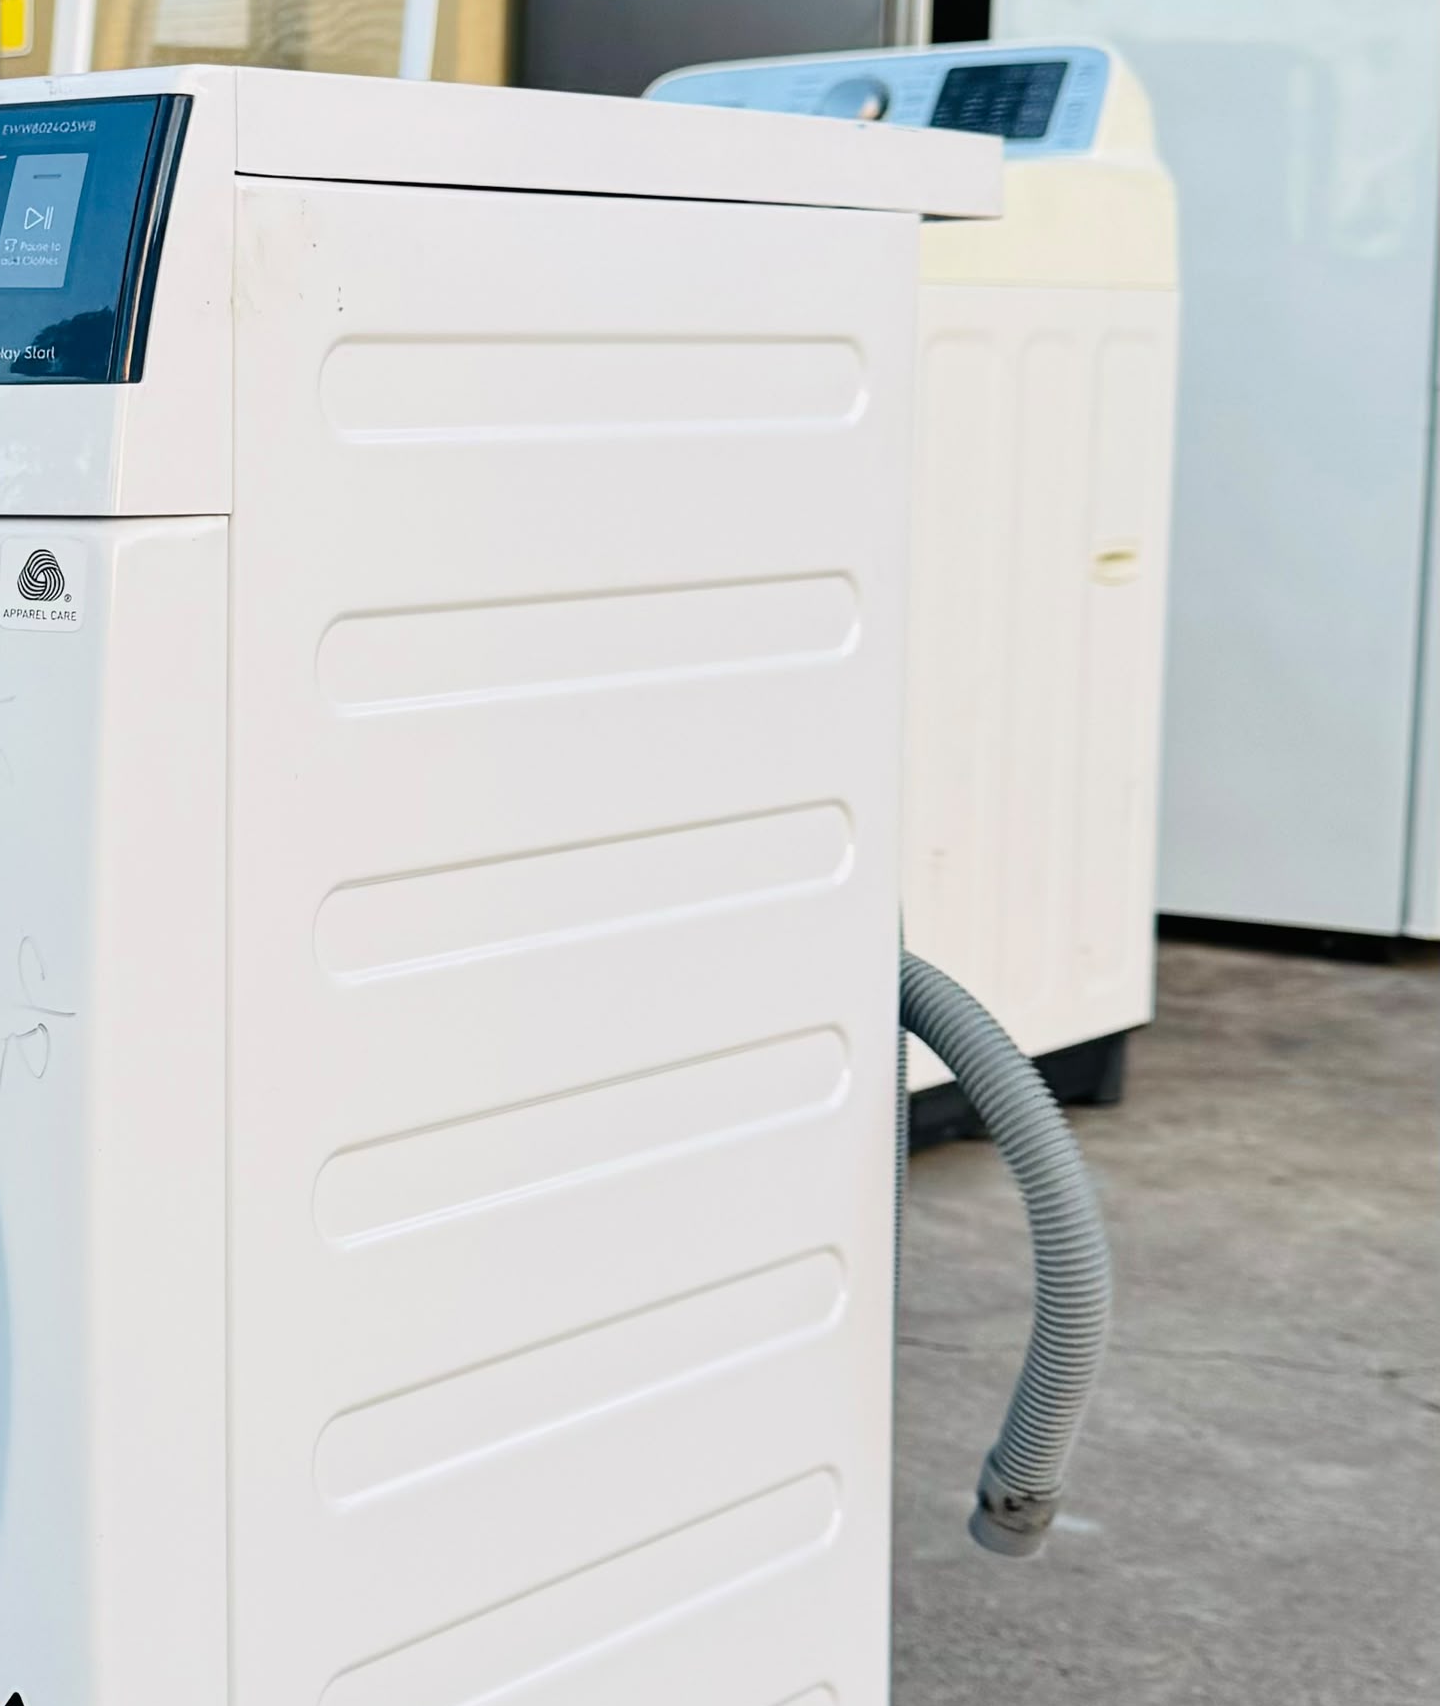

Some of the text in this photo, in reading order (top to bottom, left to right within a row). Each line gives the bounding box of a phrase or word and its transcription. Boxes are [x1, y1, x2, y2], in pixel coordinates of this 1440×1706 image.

[22, 254, 59, 267] Clothes
[24, 345, 56, 361] Start
[2, 608, 78, 622] APPAREL CARE
